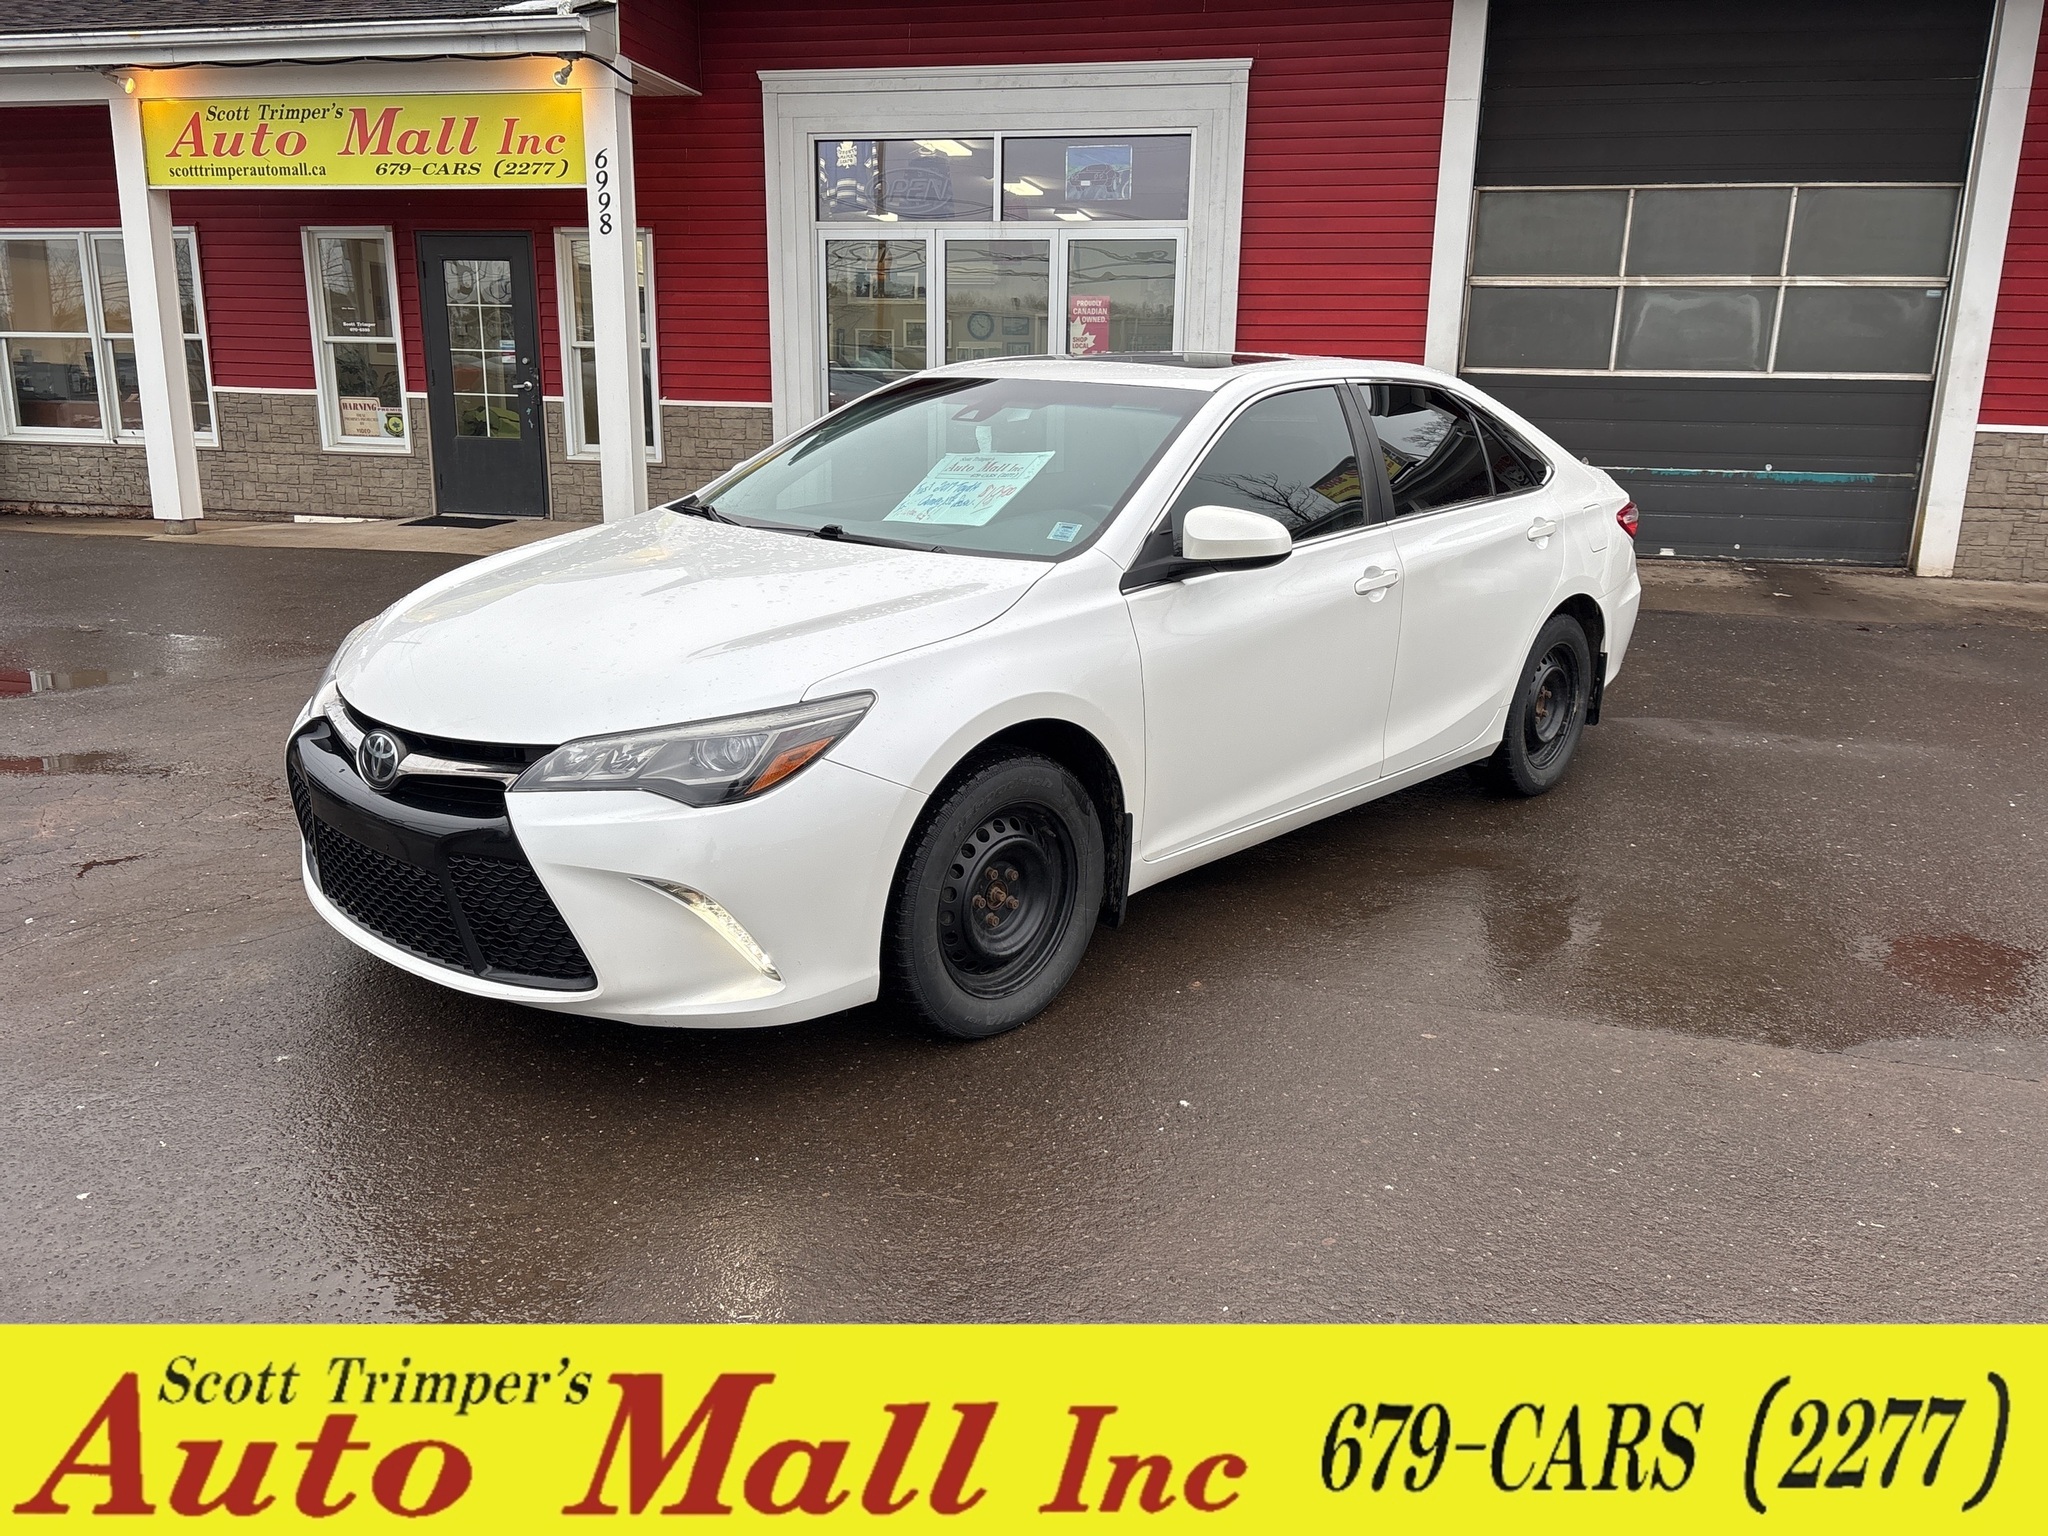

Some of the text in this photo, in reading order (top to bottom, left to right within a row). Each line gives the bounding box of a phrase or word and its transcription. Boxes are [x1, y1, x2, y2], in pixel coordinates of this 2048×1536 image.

[206, 103, 344, 124] Scott Trimper's
[166, 106, 566, 158] Auto Mall Inc
[169, 163, 327, 180] scotttrimperautomall.ca
[375, 158, 570, 178] 679-CARS (2277)
[869, 178, 950, 202] OPEN
[341, 402, 377, 411] WARNING
[944, 461, 976, 472] Auto
[977, 460, 1011, 472] Mall
